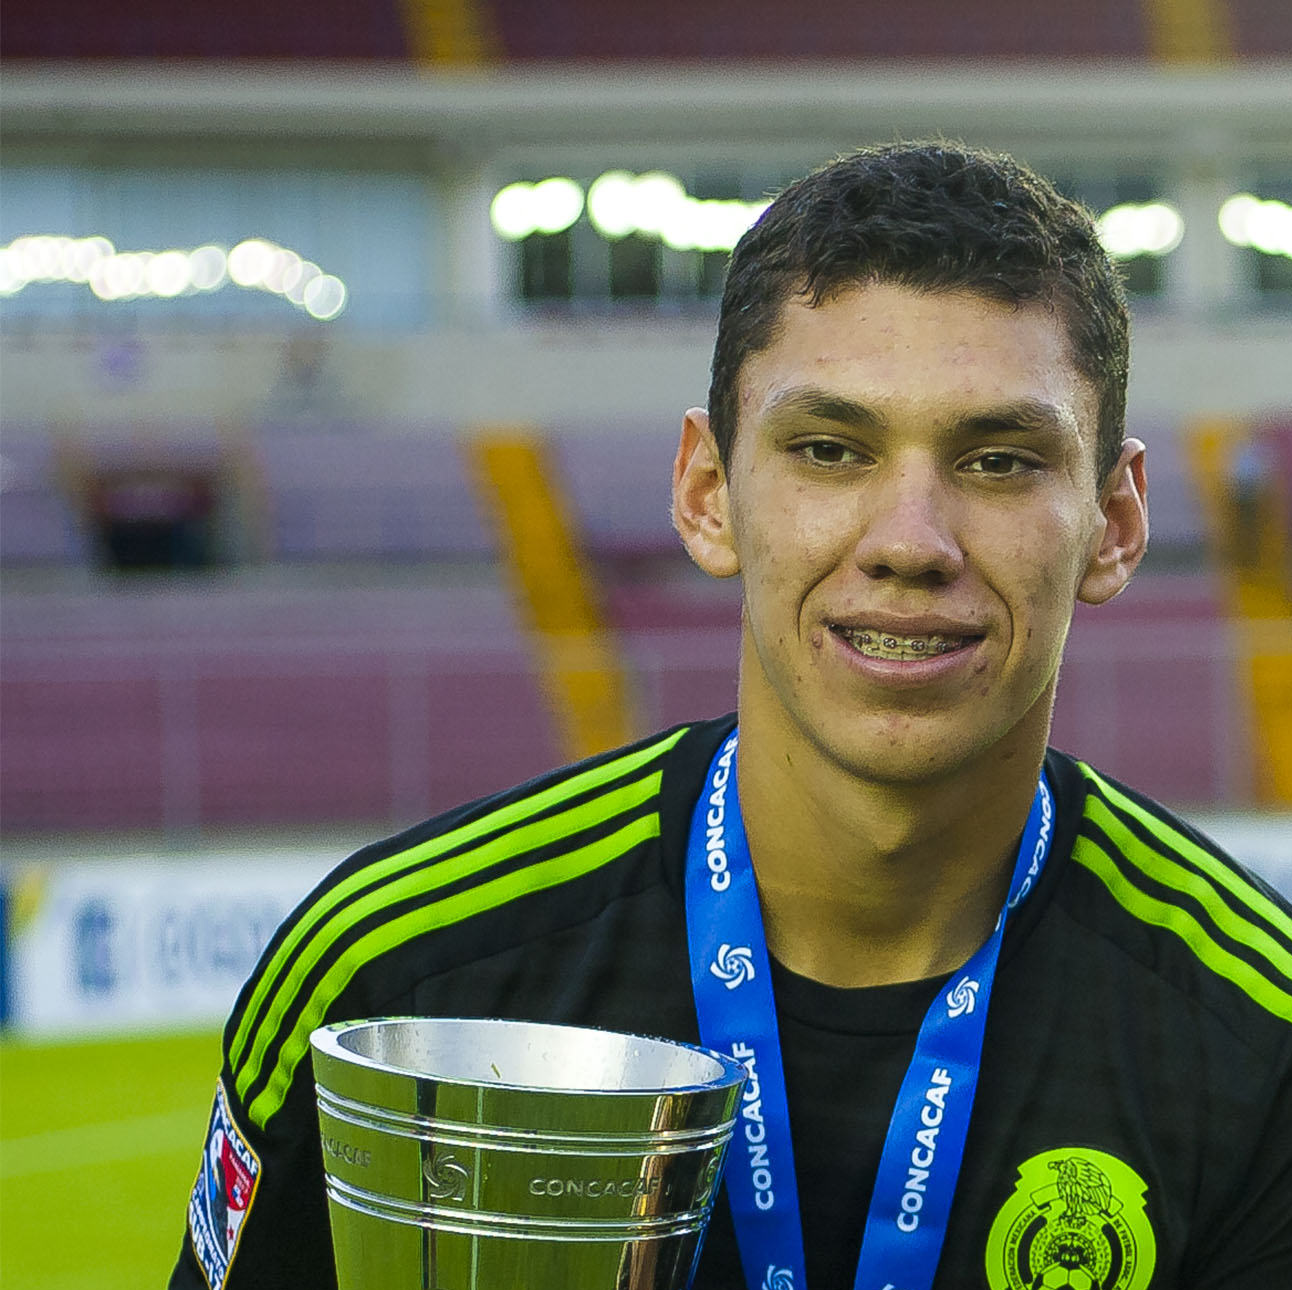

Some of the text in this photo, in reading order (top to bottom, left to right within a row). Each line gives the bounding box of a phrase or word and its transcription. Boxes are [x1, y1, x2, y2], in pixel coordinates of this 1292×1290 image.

[706, 736, 738, 892] CONCACAF
[1007, 780, 1052, 908] CONCAC
[528, 1176, 662, 1198] CONCACAF
[732, 1042, 775, 1211] CONCACAF
[896, 1068, 952, 1233] CONCACAF
